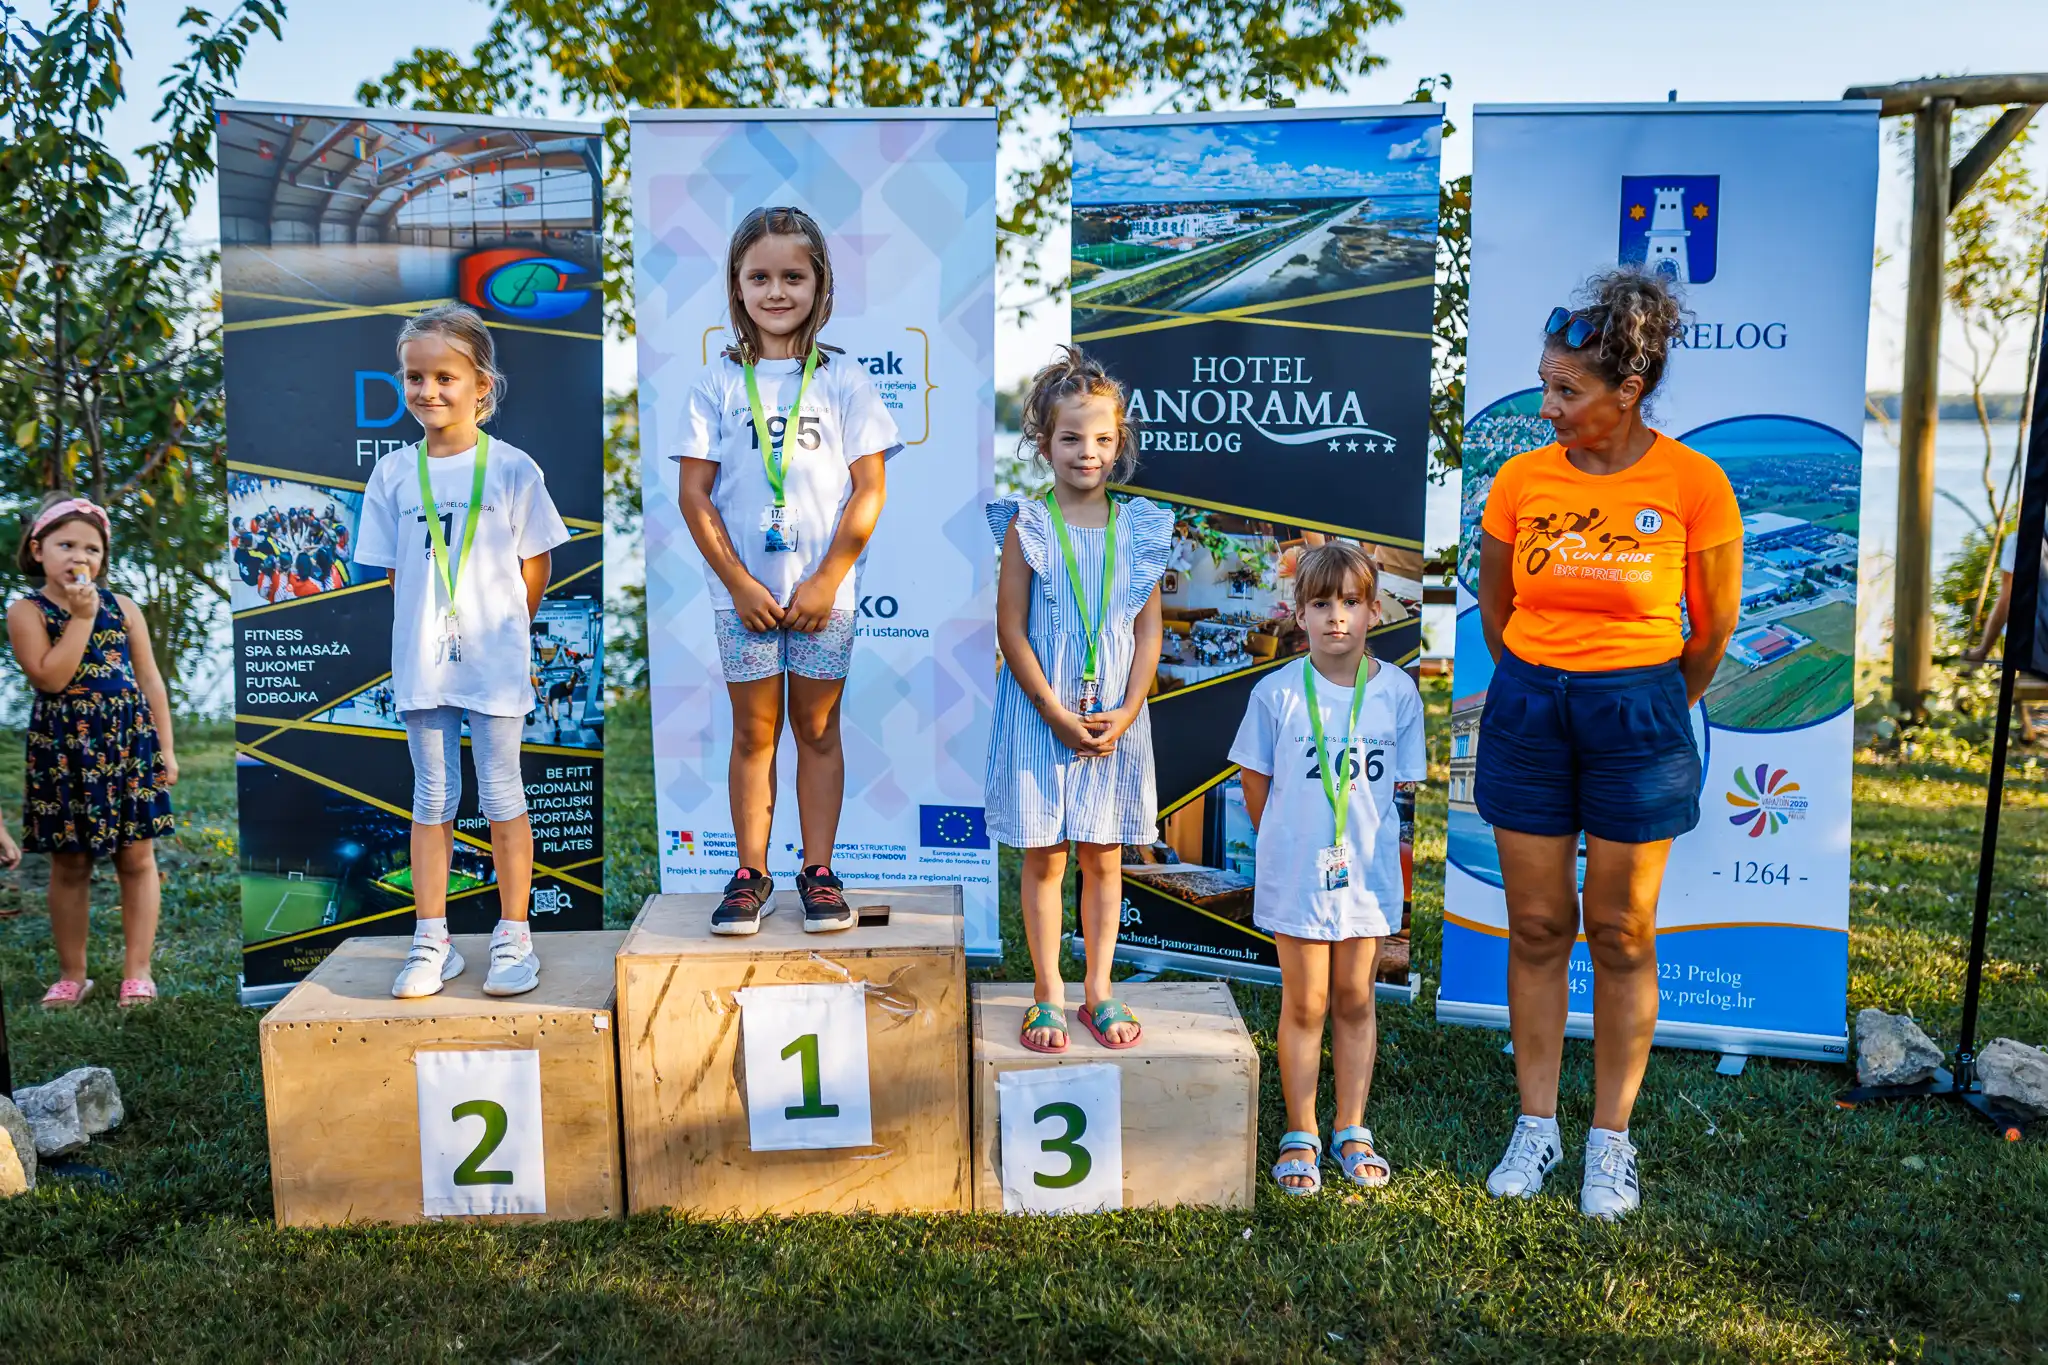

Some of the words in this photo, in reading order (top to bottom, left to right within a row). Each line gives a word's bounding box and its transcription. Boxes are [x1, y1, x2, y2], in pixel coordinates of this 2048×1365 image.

[1671, 322, 1788, 350] RELOG
[1192, 356, 1313, 384] HOTEL
[354, 370, 406, 428] D
[881, 391, 897, 400] zvoj
[1126, 388, 1368, 426] ANORAMA
[746, 416, 821, 450] 195
[1140, 431, 1242, 453] PRELOG
[357, 440, 409, 466] FIT
[417, 513, 452, 549] 71
[1616, 553, 1655, 563] RIDE
[1553, 564, 1579, 577] BK
[1581, 566, 1653, 583] PRELOG
[244, 629, 304, 641] FITNESS
[866, 624, 870, 637] i
[872, 626, 930, 638] ustanova
[245, 645, 273, 657] SPA
[276, 645, 287, 656] &
[290, 641, 351, 656] MASAŽA
[245, 660, 316, 673] RUKOMET
[246, 677, 301, 688] FUTSAL
[246, 691, 319, 704] ODBOJKA
[1305, 746, 1385, 782] 266
[546, 768, 564, 779] BE
[566, 766, 593, 777] FITT
[524, 781, 593, 796] KCIONALNI
[526, 796, 593, 810] LITACIJSKI
[1790, 800, 1808, 808] 2020
[458, 818, 491, 829] PRIP
[532, 827, 560, 840] ONG
[563, 825, 593, 837] MAN
[702, 831, 736, 839] Operativ
[542, 839, 593, 853] PILATES
[703, 840, 737, 848] KONKUR
[860, 844, 907, 852] STRUKTURNI
[708, 850, 738, 858] KOHEZI
[832, 852, 871, 861] VESTICIJSKI
[872, 853, 907, 861] FONDOVI
[666, 867, 698, 876] Projekt
[700, 867, 707, 877] je
[836, 871, 880, 881] Europskog
[882, 872, 906, 880] fonda
[919, 874, 962, 883] regionalni
[963, 875, 992, 884] razvoj.
[1733, 861, 1790, 886] 1264
[1688, 965, 1742, 988] Prelog
[1568, 978, 1587, 994] 45
[1660, 989, 1756, 1010] w.prelog.hr
[779, 1033, 840, 1120] 1
[451, 1099, 514, 1186] 2
[1032, 1101, 1092, 1189] 3
